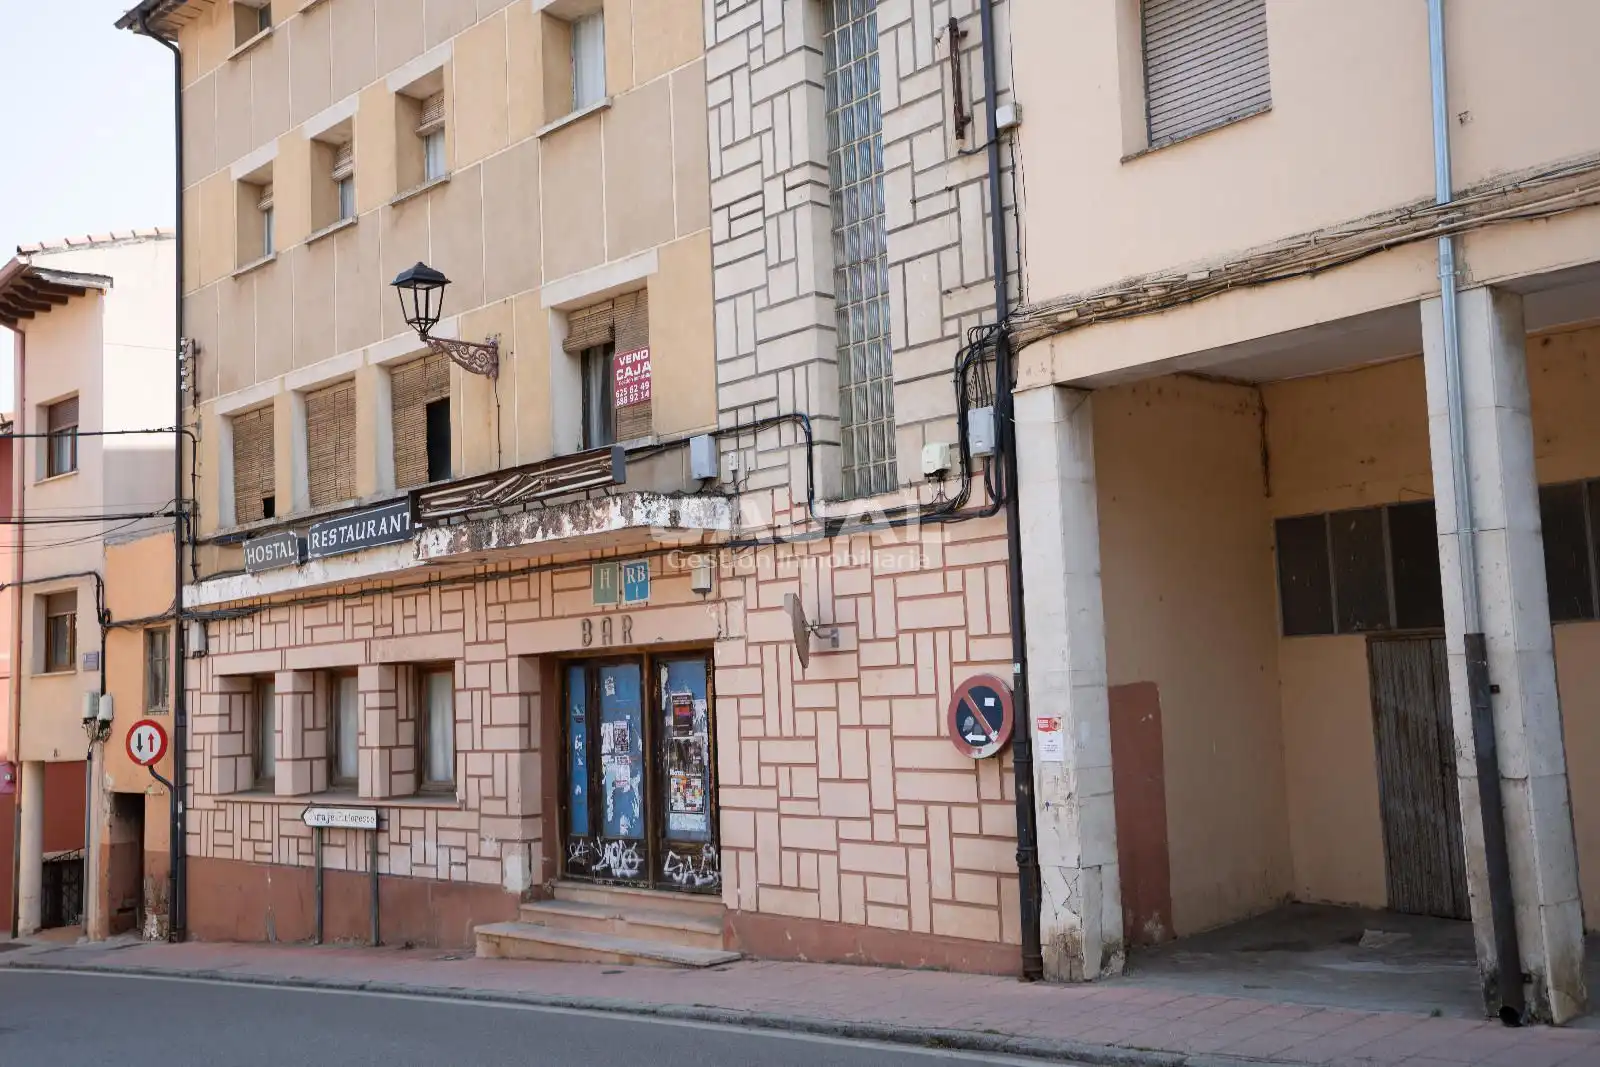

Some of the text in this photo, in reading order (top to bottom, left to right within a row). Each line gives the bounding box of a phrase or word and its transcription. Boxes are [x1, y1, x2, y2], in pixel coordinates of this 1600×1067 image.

[311, 511, 418, 549] RESTAURANT
[246, 539, 295, 565] HOSTAL
[626, 565, 646, 584] RB
[581, 614, 633, 647] BAR
